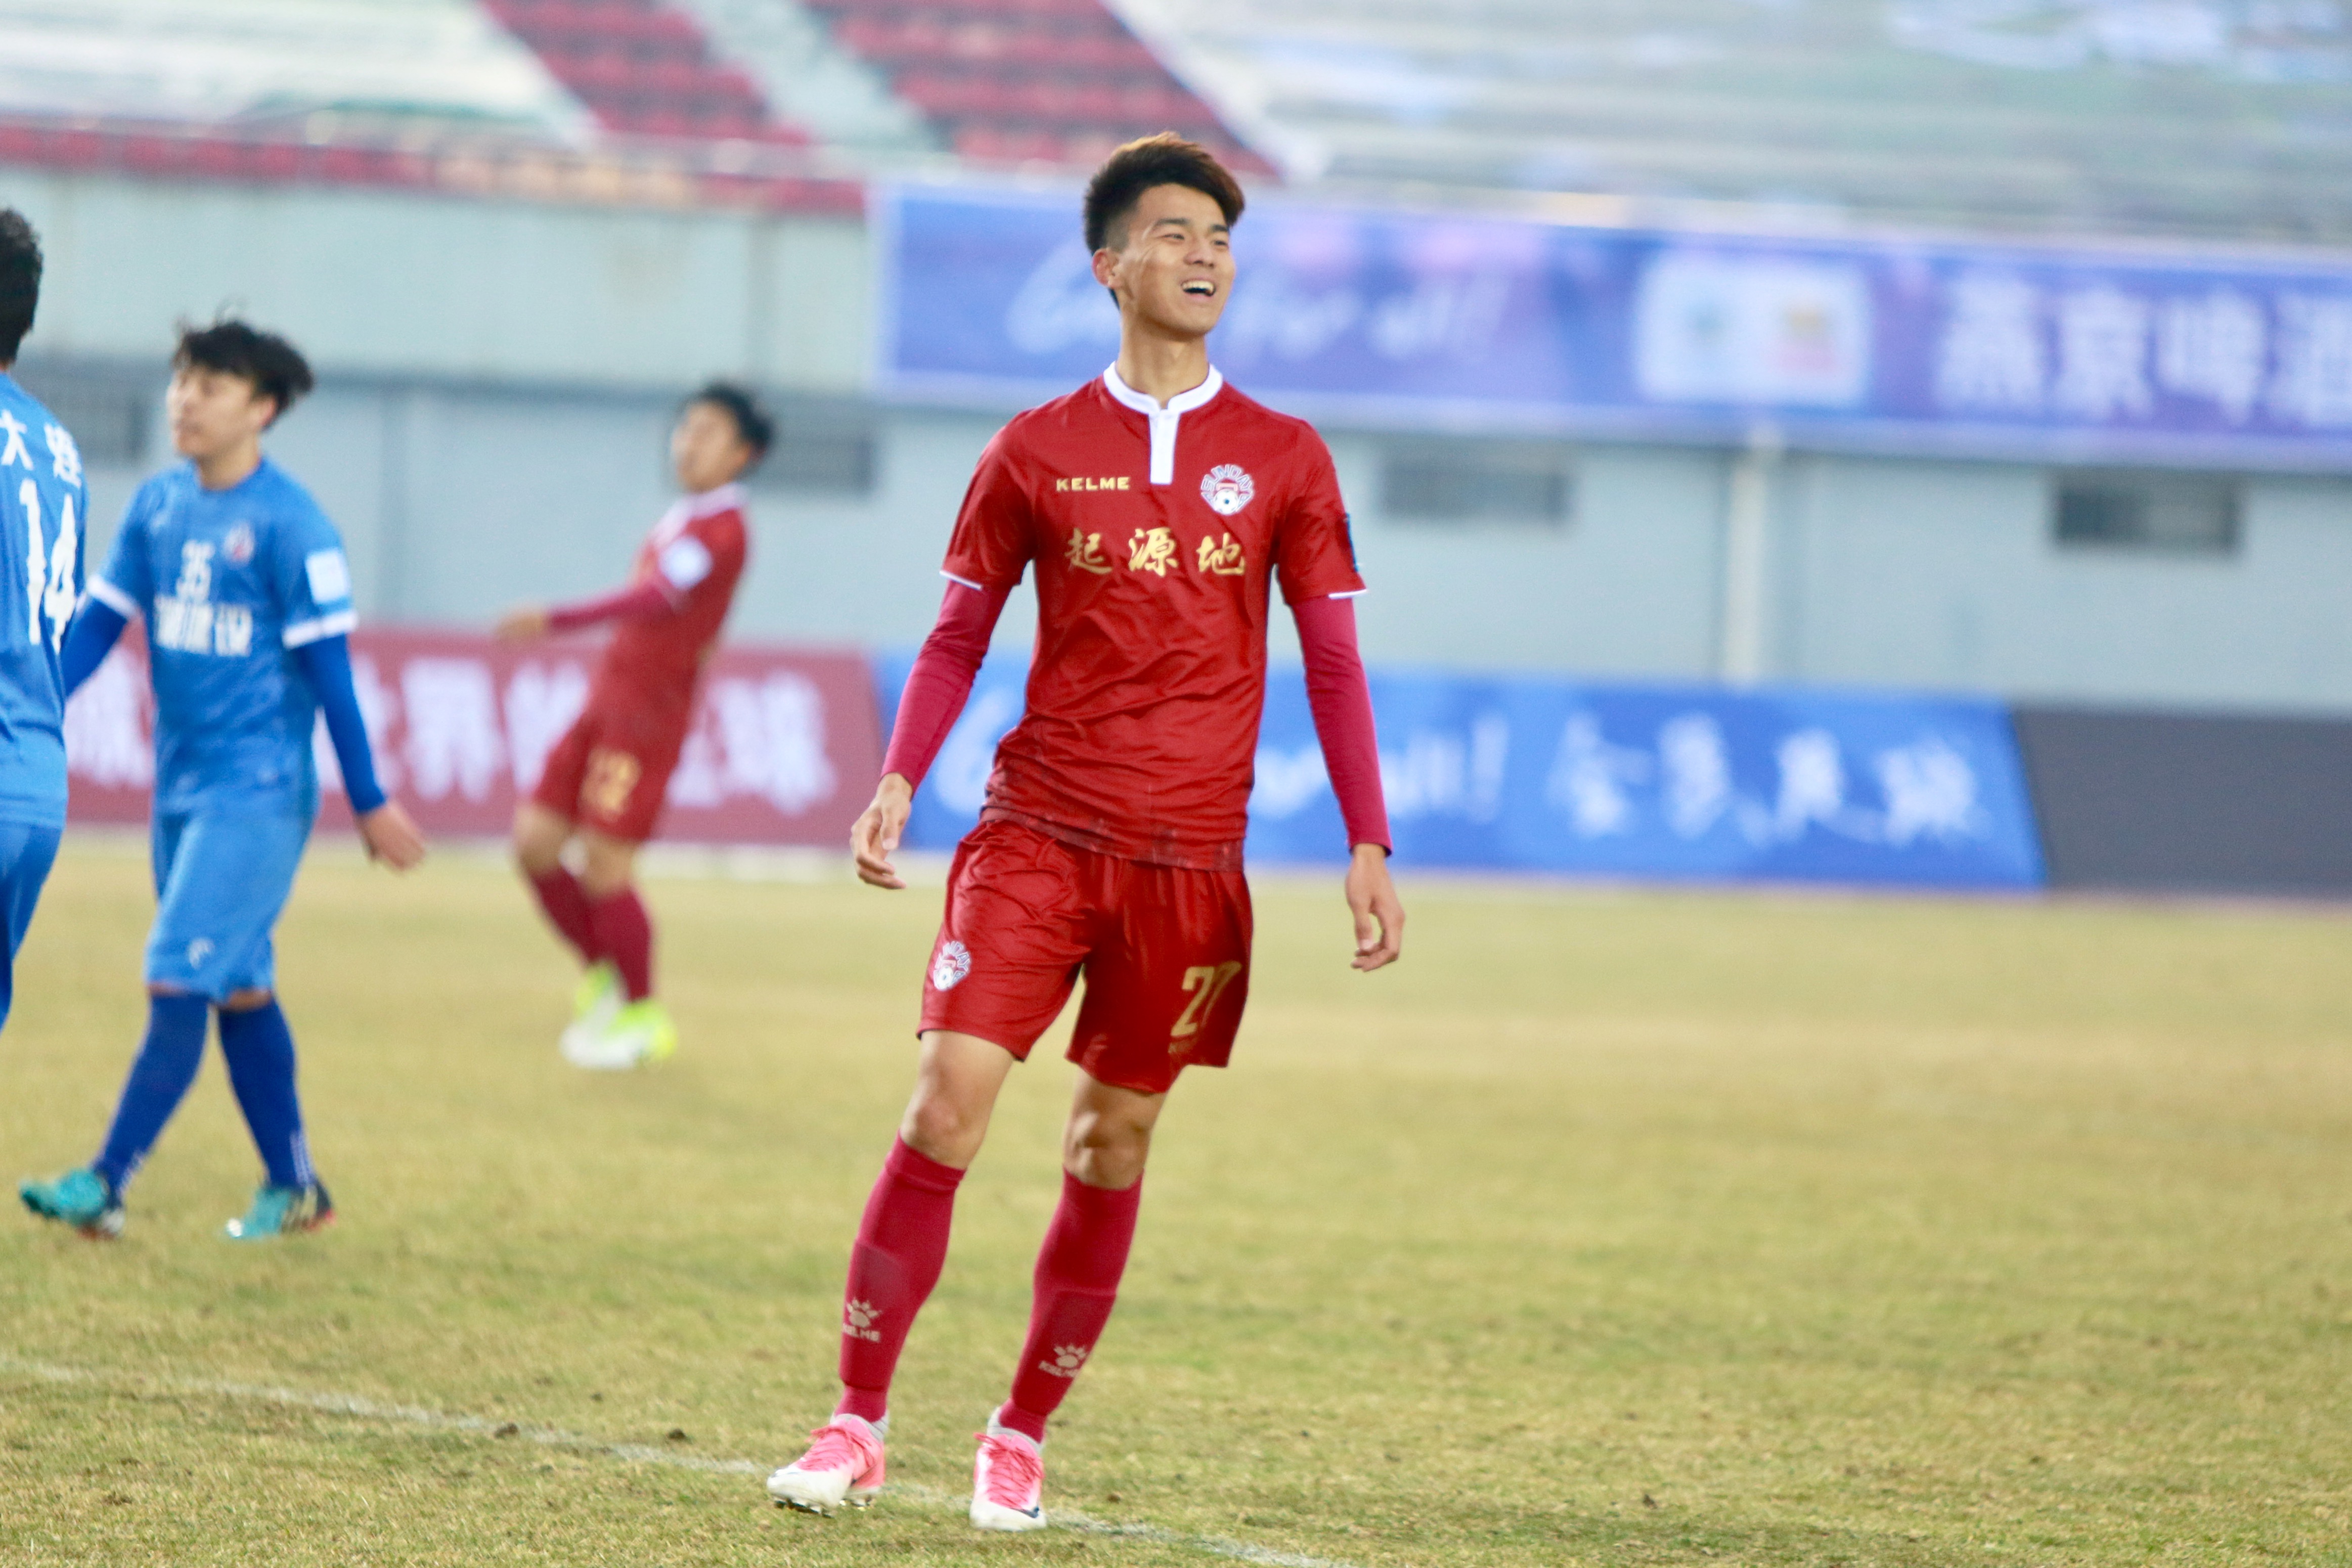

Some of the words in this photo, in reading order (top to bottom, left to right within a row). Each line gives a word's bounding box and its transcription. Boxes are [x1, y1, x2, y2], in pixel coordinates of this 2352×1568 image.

[1056, 476, 1131, 491] KELME
[19, 478, 77, 654] 14
[1064, 526, 1247, 577] 起源地
